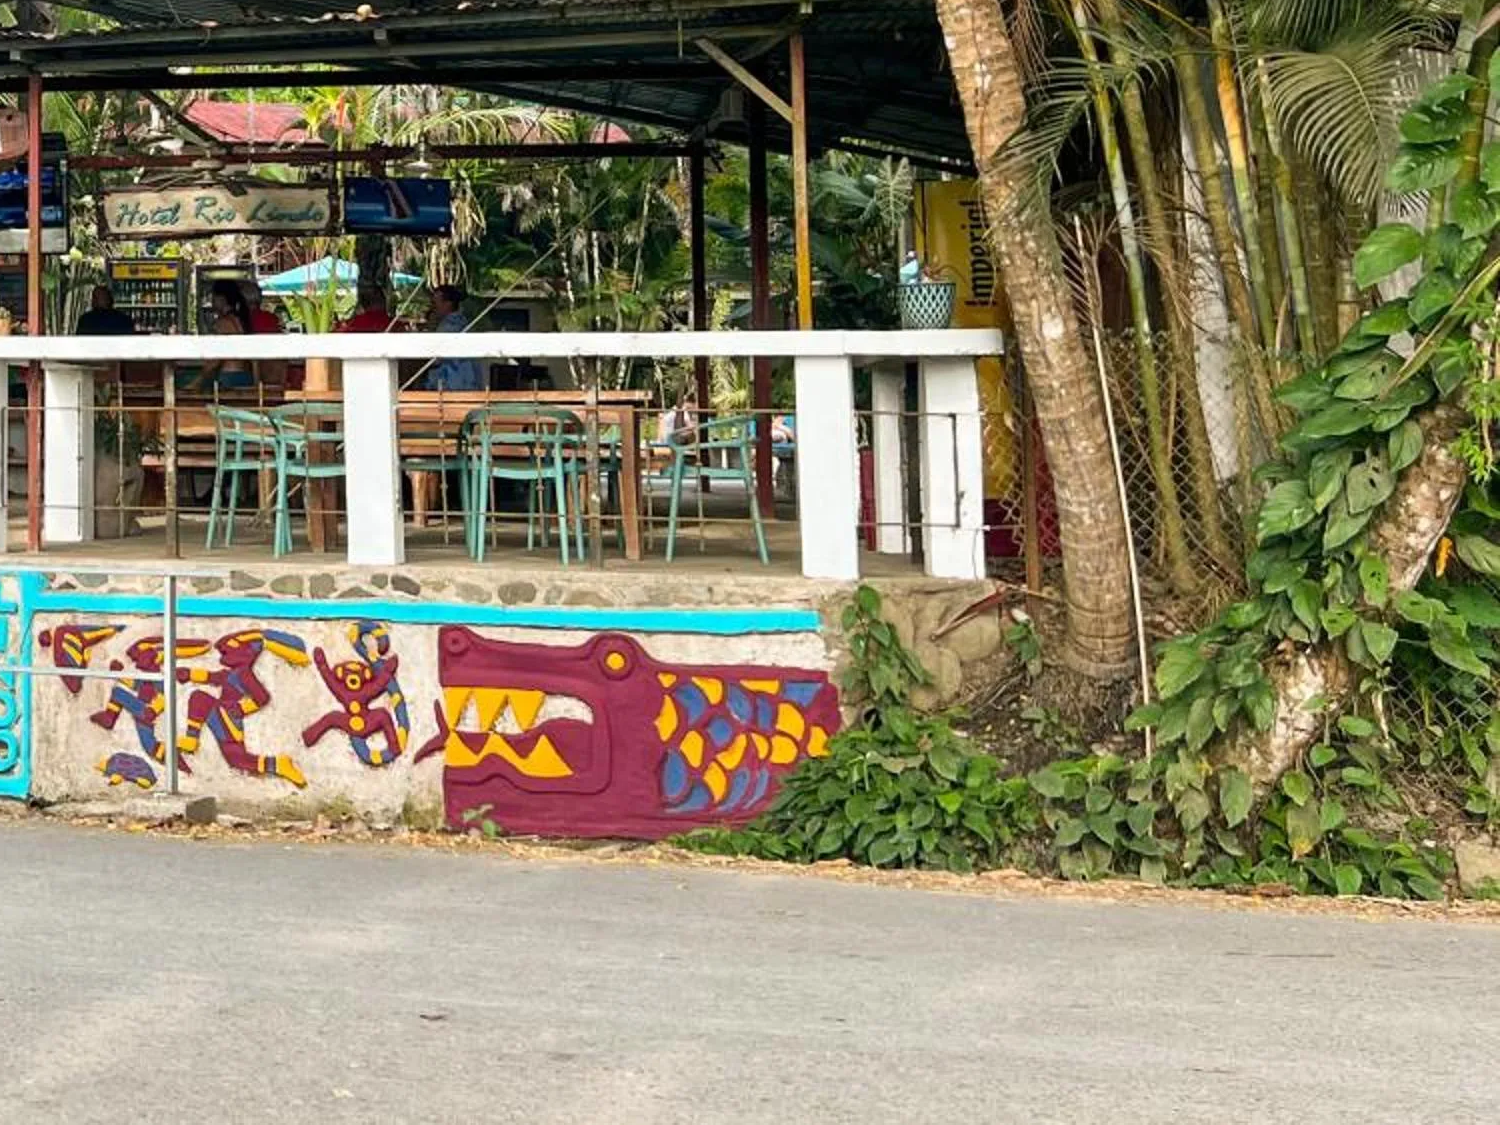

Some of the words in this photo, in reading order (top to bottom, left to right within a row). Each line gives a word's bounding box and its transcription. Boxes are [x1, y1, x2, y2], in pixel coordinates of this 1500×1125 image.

[116, 201, 181, 228] Hotel
[193, 196, 237, 225] Rio
[246, 199, 325, 225] Lindo
[958, 200, 997, 307] Imperial
